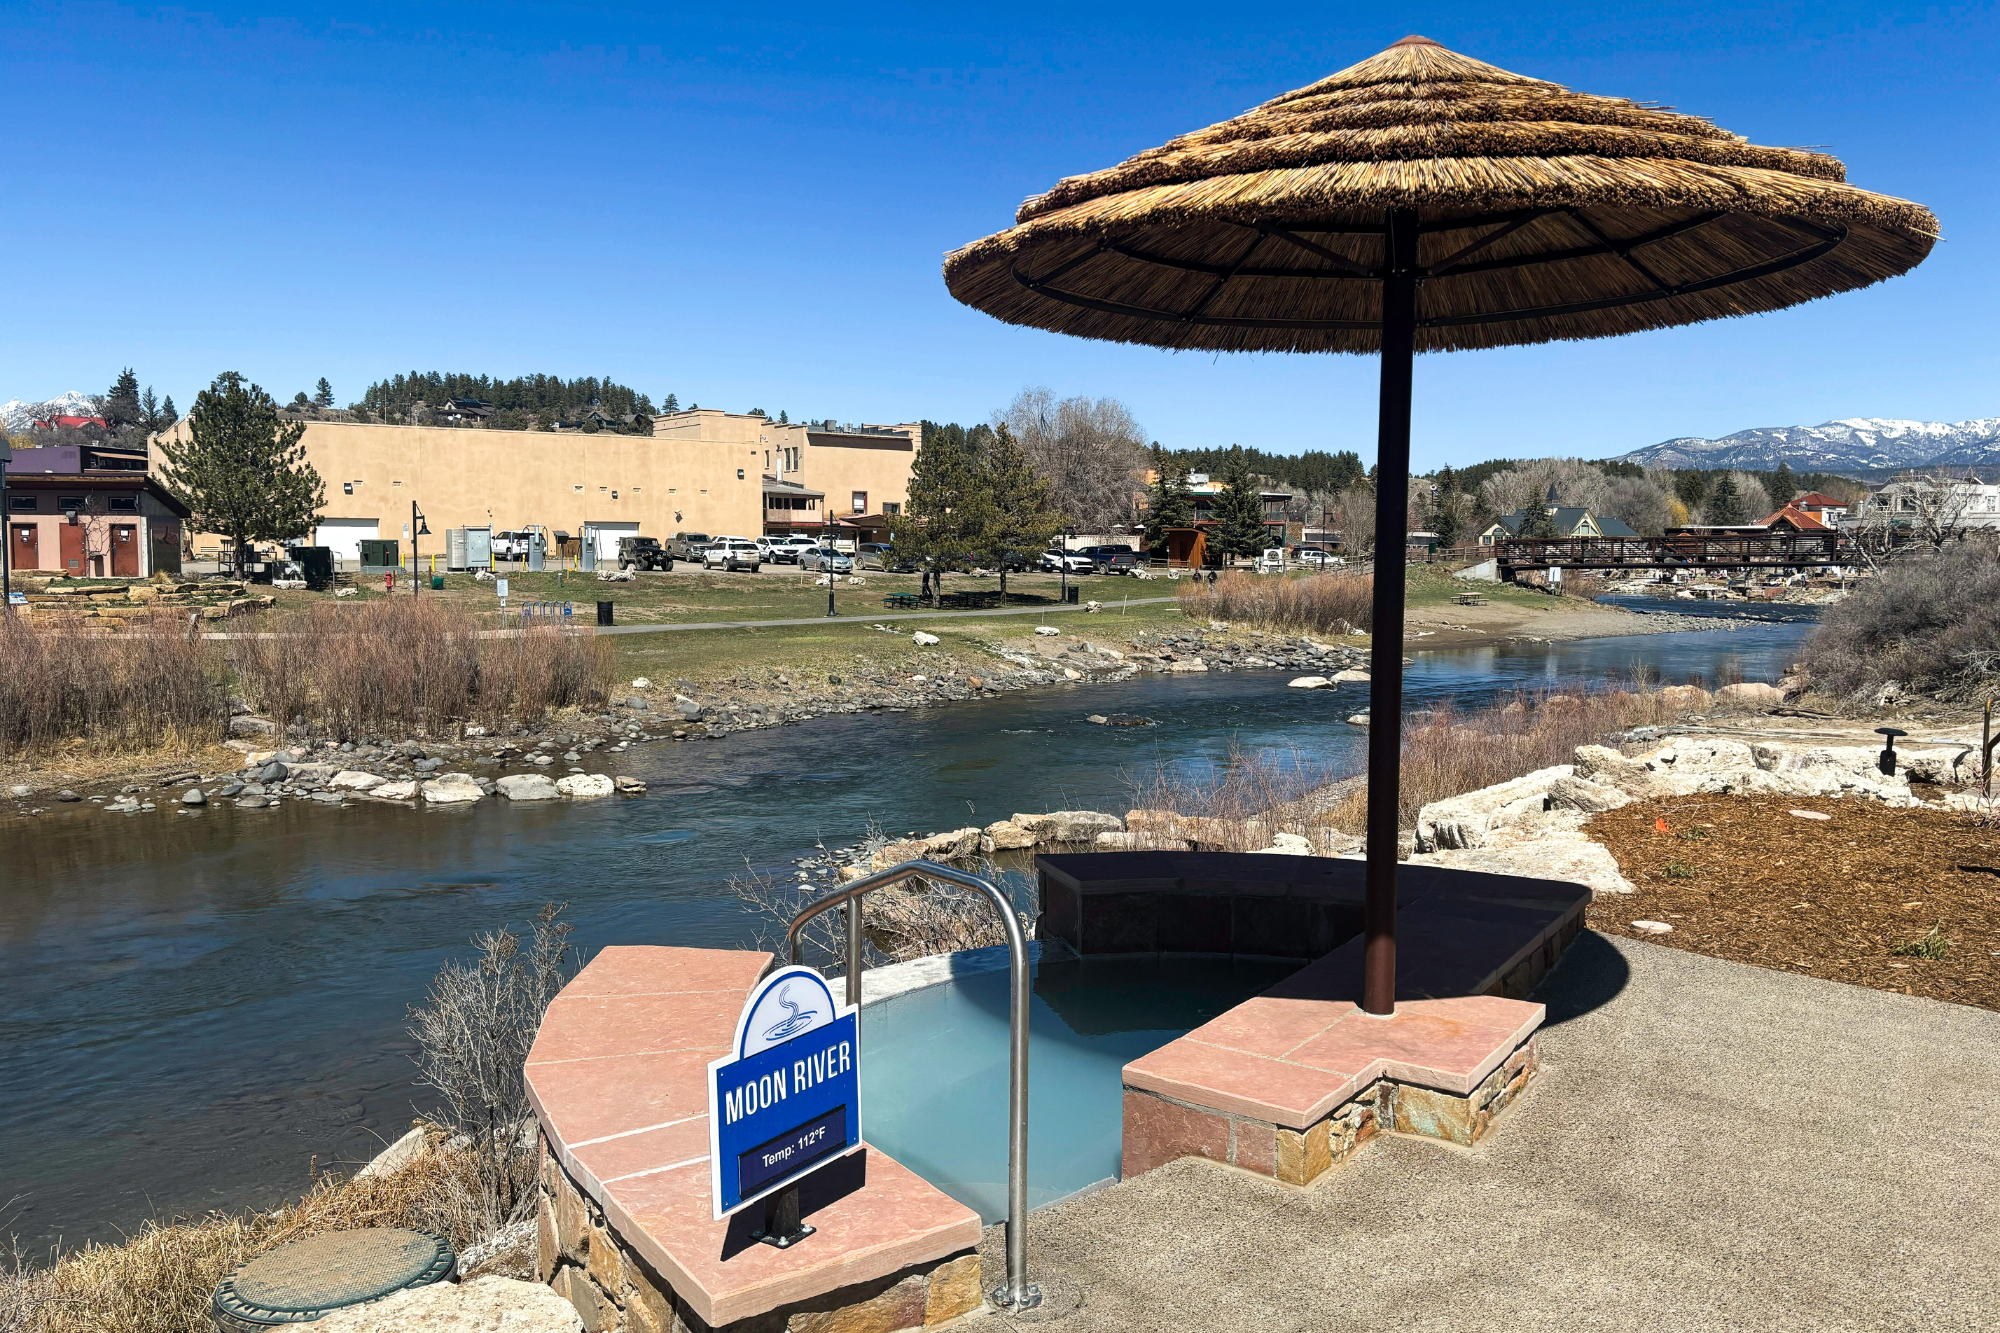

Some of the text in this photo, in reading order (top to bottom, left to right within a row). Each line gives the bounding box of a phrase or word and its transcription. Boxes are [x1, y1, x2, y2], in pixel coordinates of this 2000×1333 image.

[725, 1040, 850, 1125] MOON RIVER
[762, 1126, 826, 1168] Temp: 112°F
